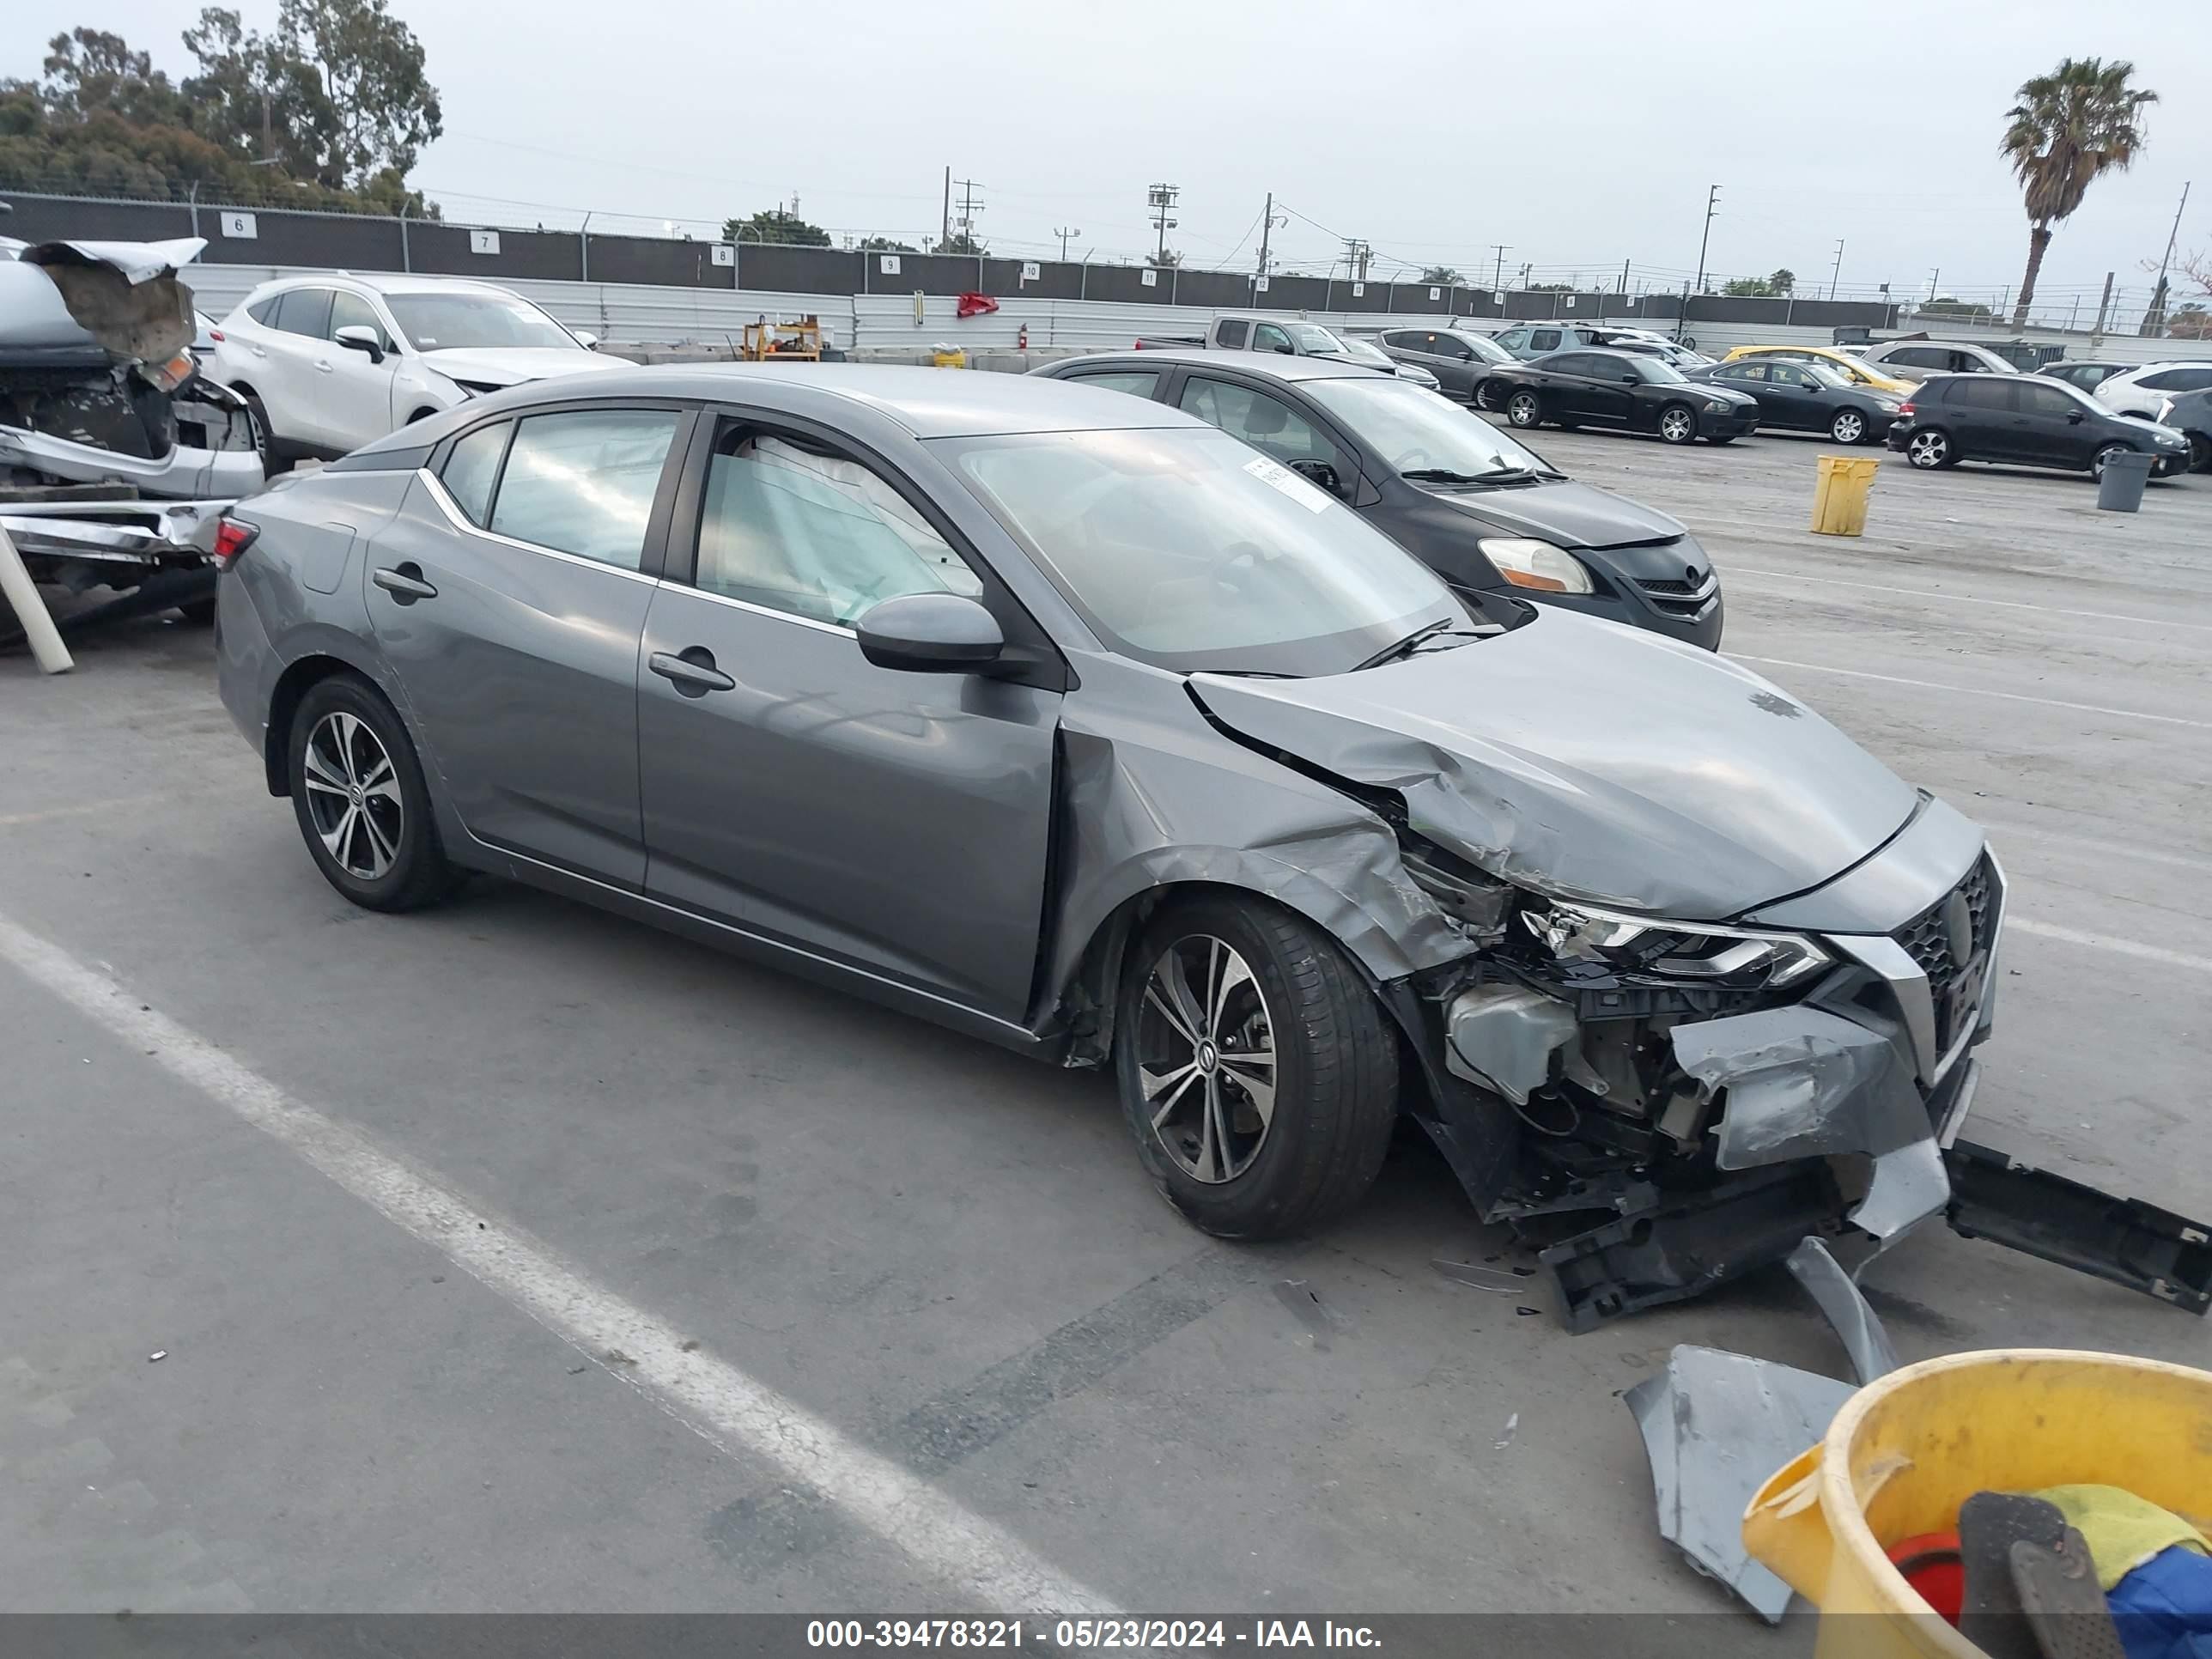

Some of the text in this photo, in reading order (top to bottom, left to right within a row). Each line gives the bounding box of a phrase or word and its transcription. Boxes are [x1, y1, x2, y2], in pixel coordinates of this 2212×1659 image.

[235, 219, 244, 232] 6
[482, 237, 489, 247] 7
[720, 251, 726, 261] 8
[888, 260, 894, 270] 9
[1028, 267, 1036, 276] 10
